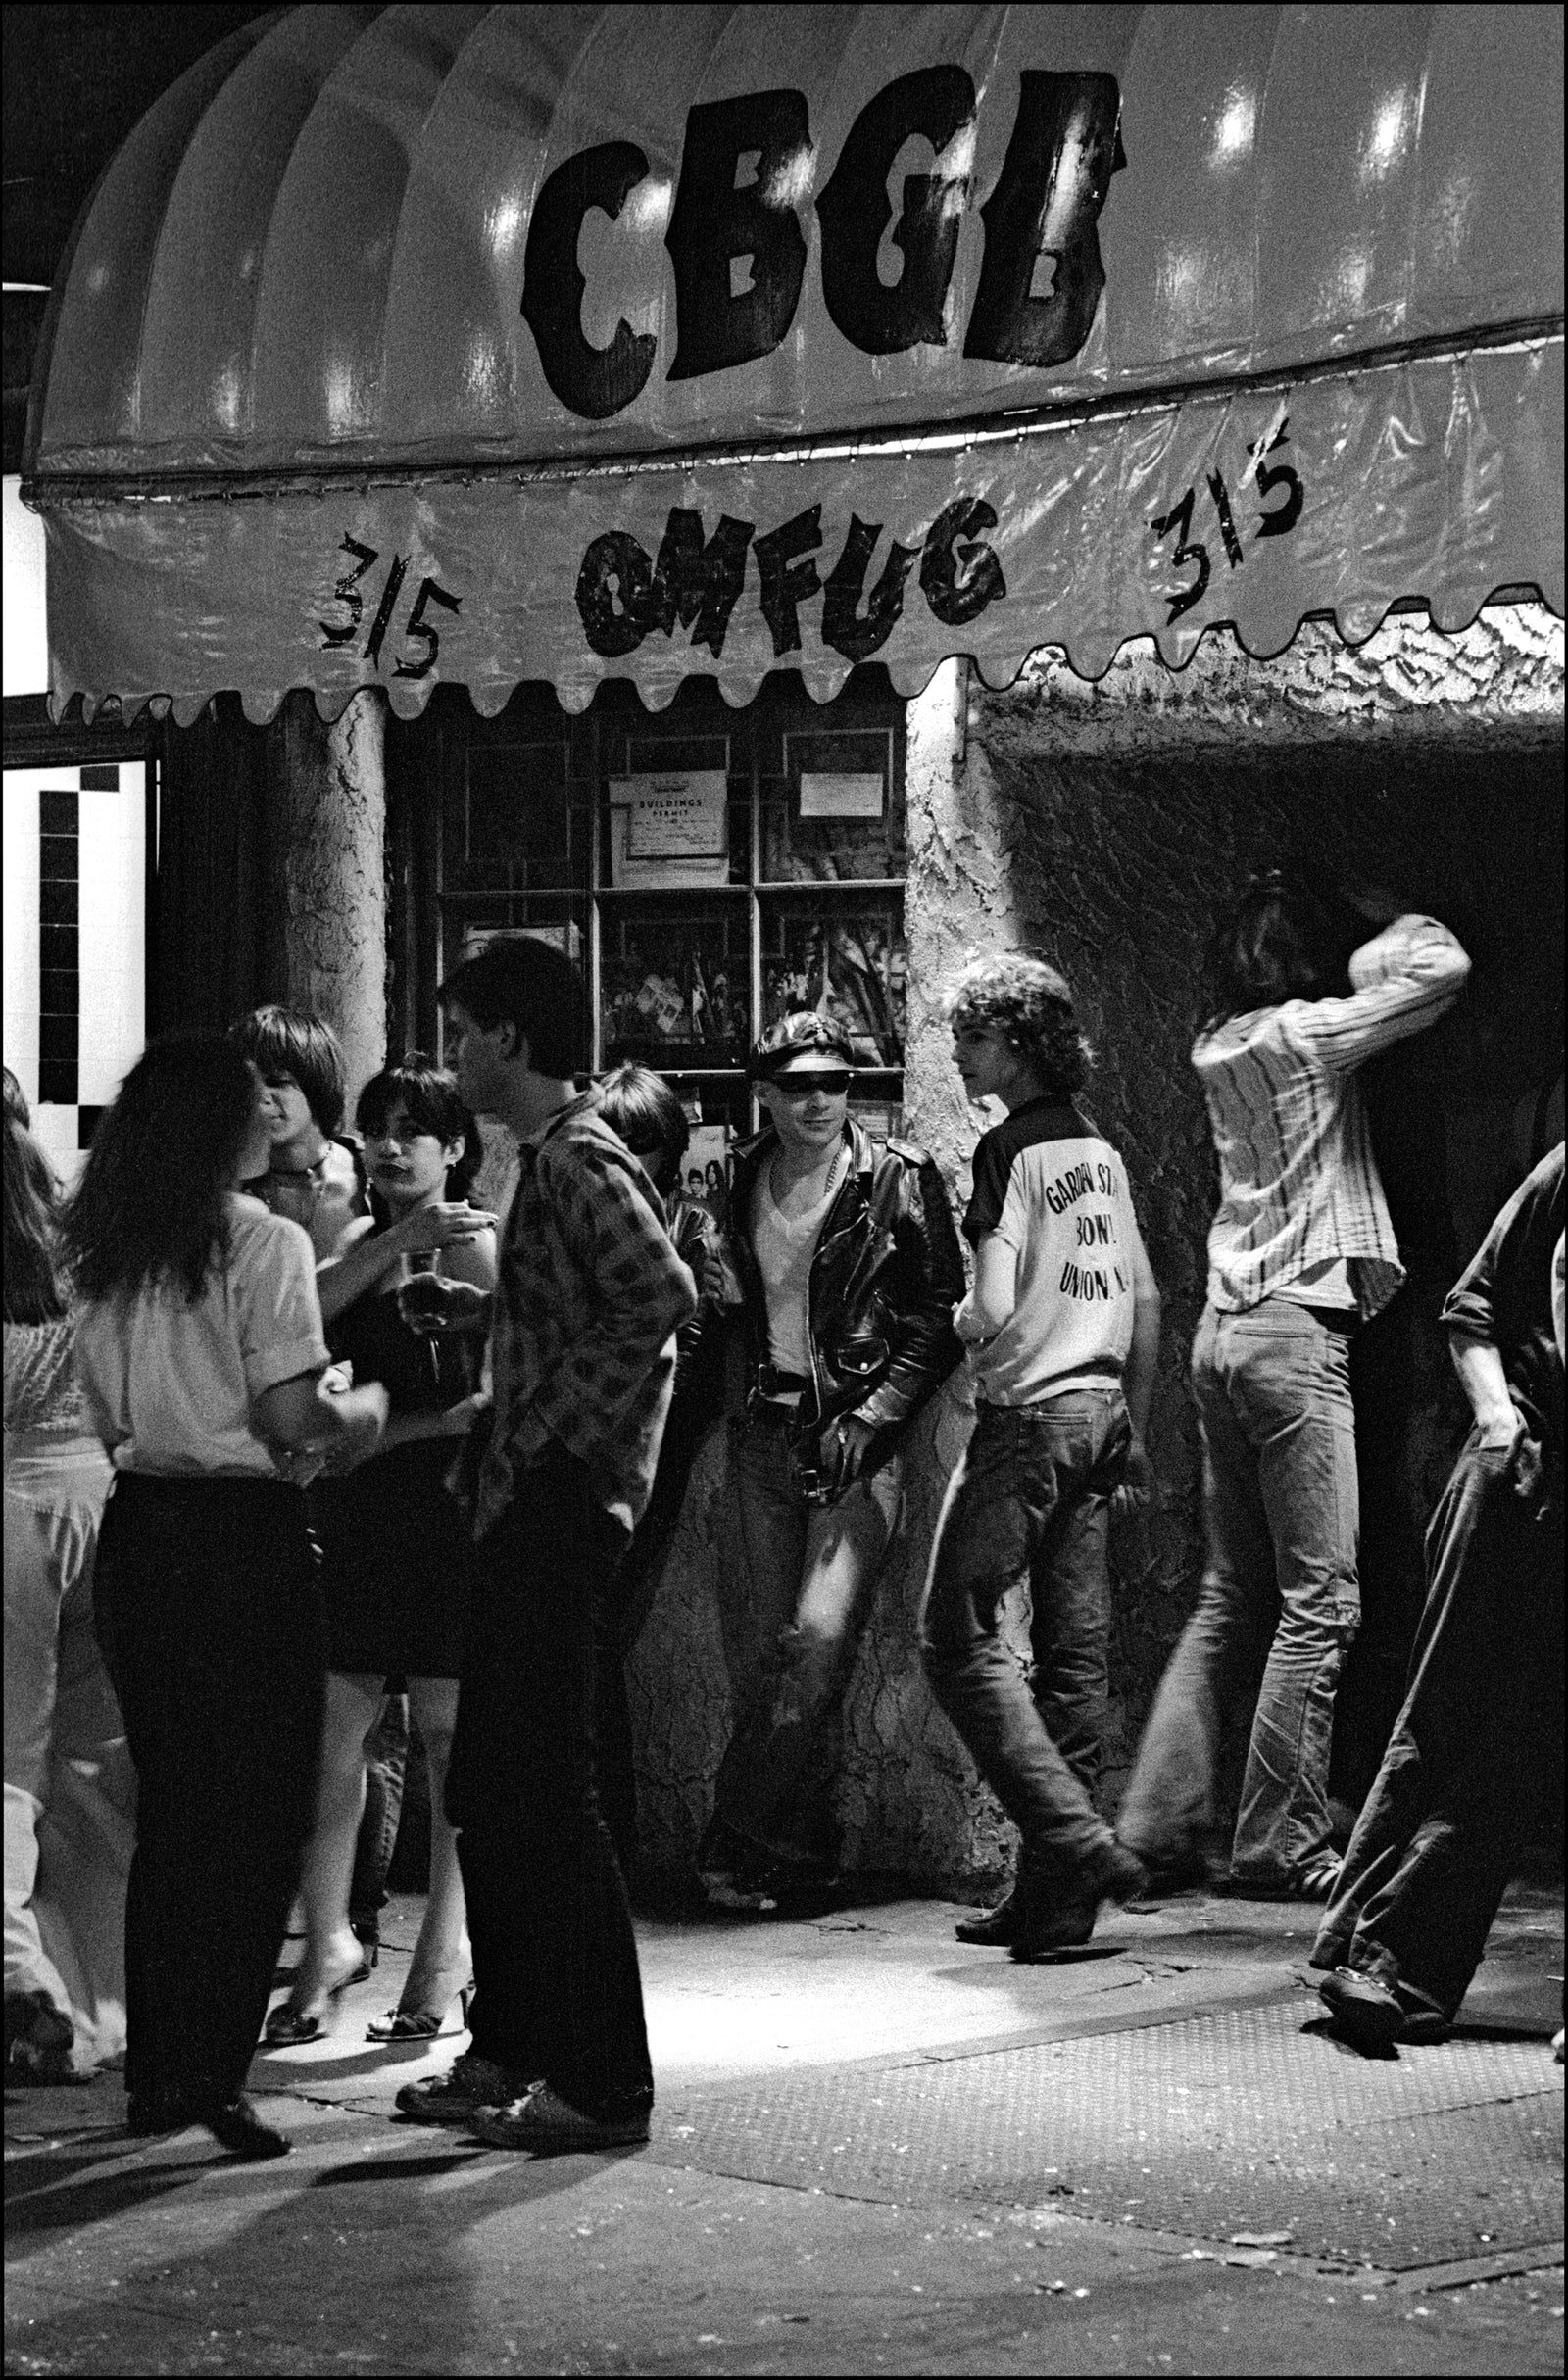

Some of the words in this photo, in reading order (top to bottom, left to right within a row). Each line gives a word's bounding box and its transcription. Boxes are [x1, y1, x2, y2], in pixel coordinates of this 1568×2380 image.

[519, 64, 1127, 420] CBGB
[318, 530, 464, 680] 315
[574, 496, 1007, 664] OMFUG
[1150, 417, 1305, 627] 315
[638, 799, 703, 809] BUILDINGS
